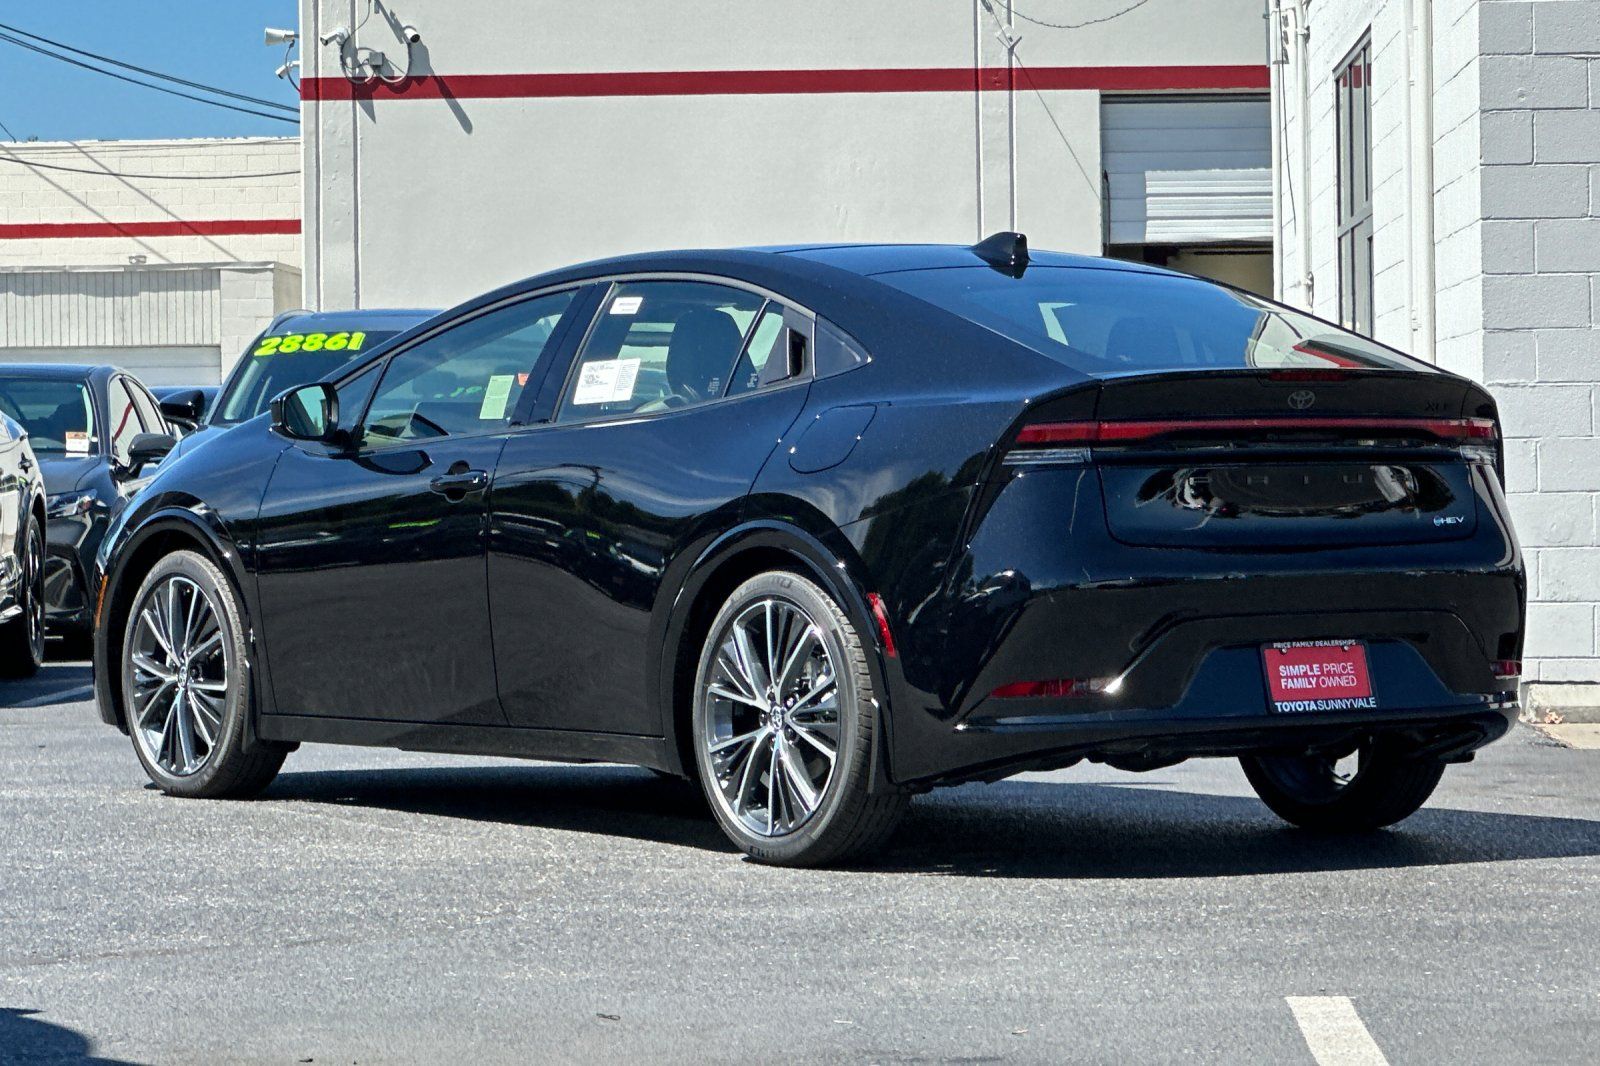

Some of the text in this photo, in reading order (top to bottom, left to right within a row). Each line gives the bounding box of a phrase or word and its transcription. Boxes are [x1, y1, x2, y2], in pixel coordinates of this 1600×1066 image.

[253, 332, 366, 357] 28861
[1315, 639, 1356, 647] DEALERSHIPS
[1279, 662, 1355, 677] SIMPLE PRICE
[1281, 675, 1357, 689] FAMILY OWNED
